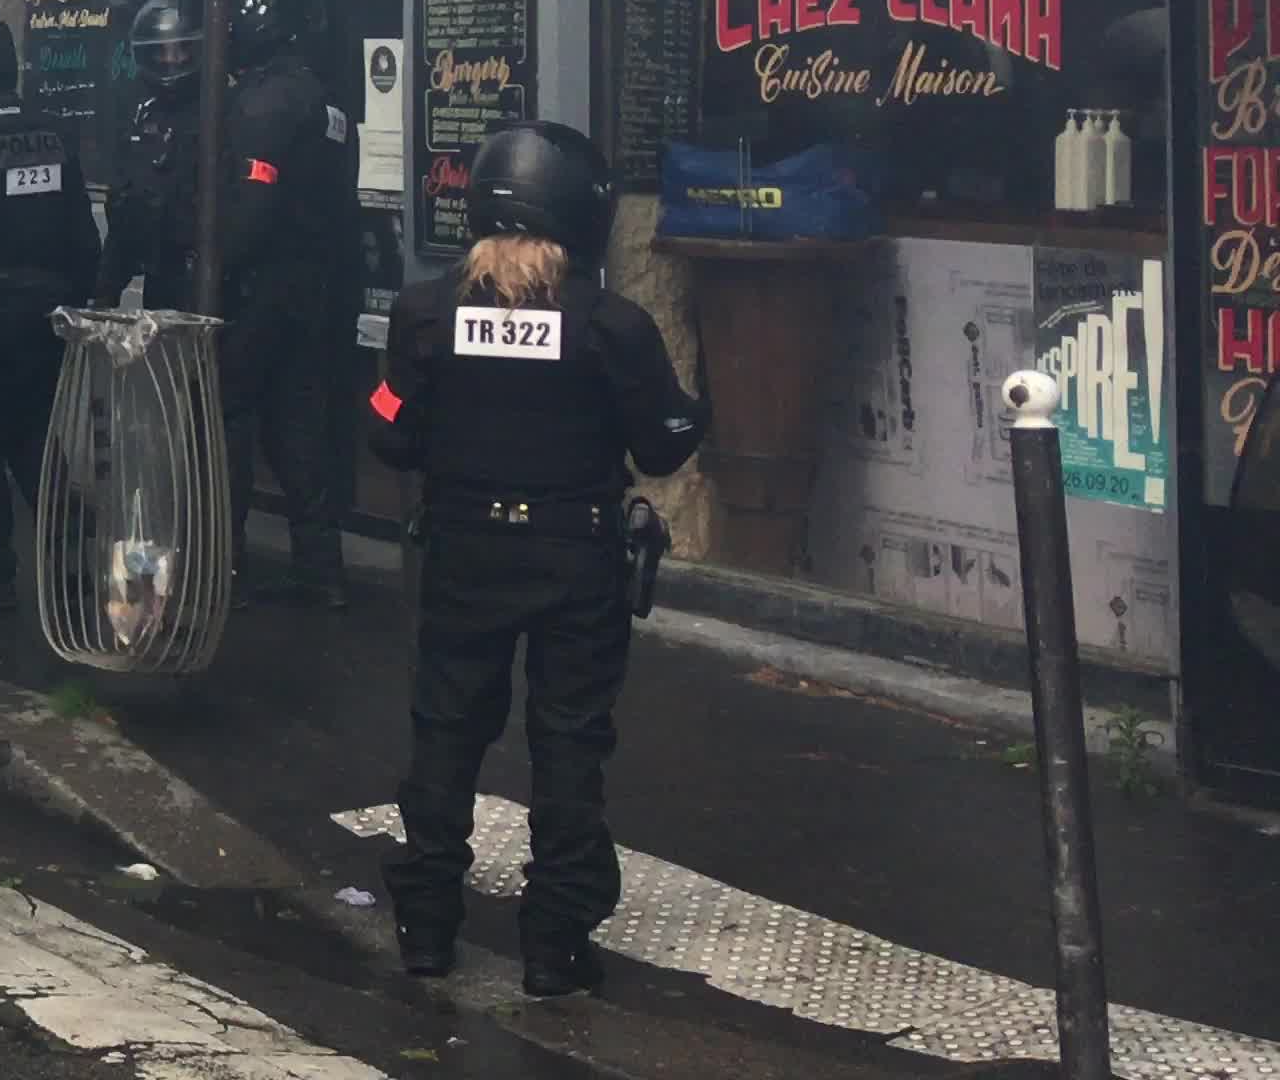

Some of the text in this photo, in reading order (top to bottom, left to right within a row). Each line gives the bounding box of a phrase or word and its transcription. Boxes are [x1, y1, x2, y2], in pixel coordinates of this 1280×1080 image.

[876, 39, 1004, 107] Maison
[17, 167, 52, 187] 223
[687, 187, 783, 209] METRO
[464, 319, 552, 347] TR 322
